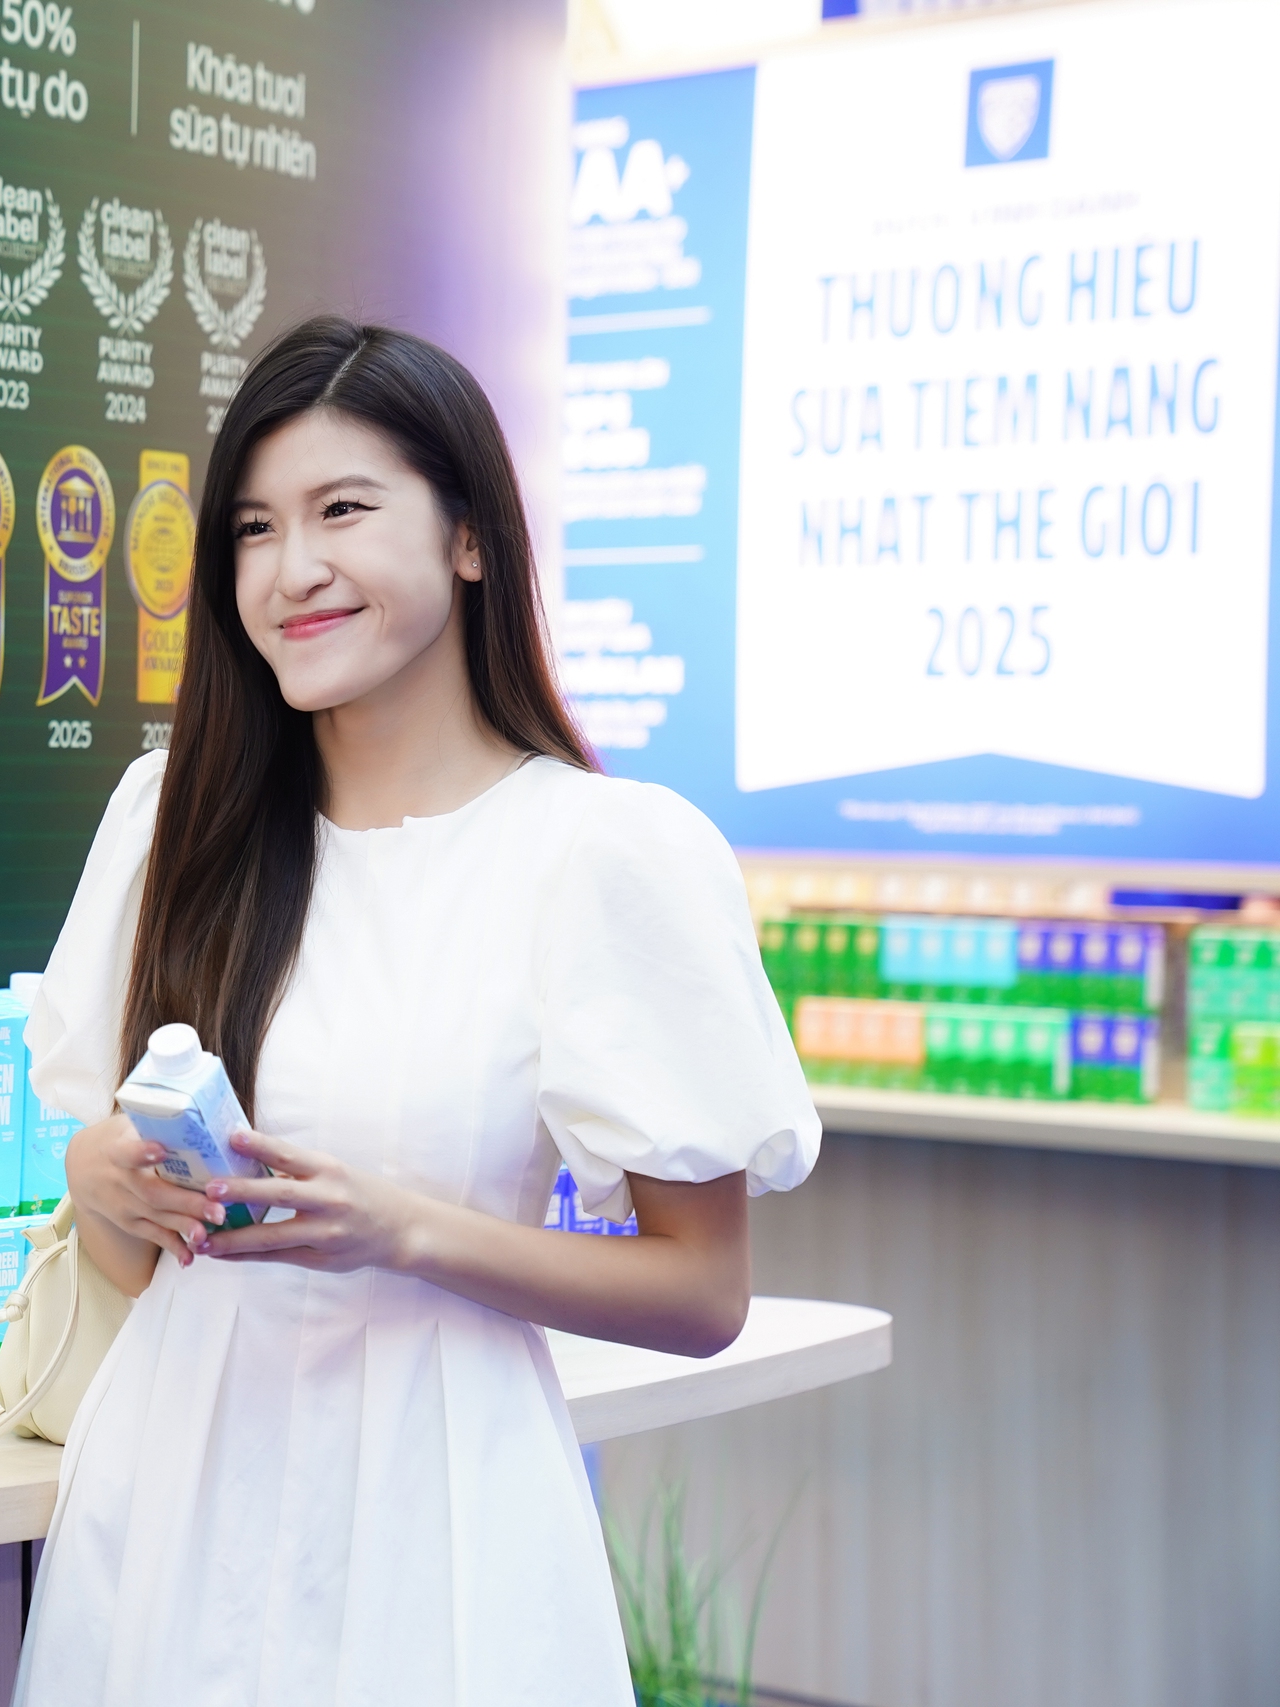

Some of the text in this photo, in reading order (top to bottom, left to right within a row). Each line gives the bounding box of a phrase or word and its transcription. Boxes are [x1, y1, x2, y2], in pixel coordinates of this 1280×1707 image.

[43, 69, 89, 122] do
[100, 196, 155, 234] clean
[102, 223, 152, 262] label
[98, 335, 154, 364] PURITY
[50, 604, 100, 637] TASTE
[924, 602, 1055, 679] 2025
[48, 720, 92, 748] 2025
